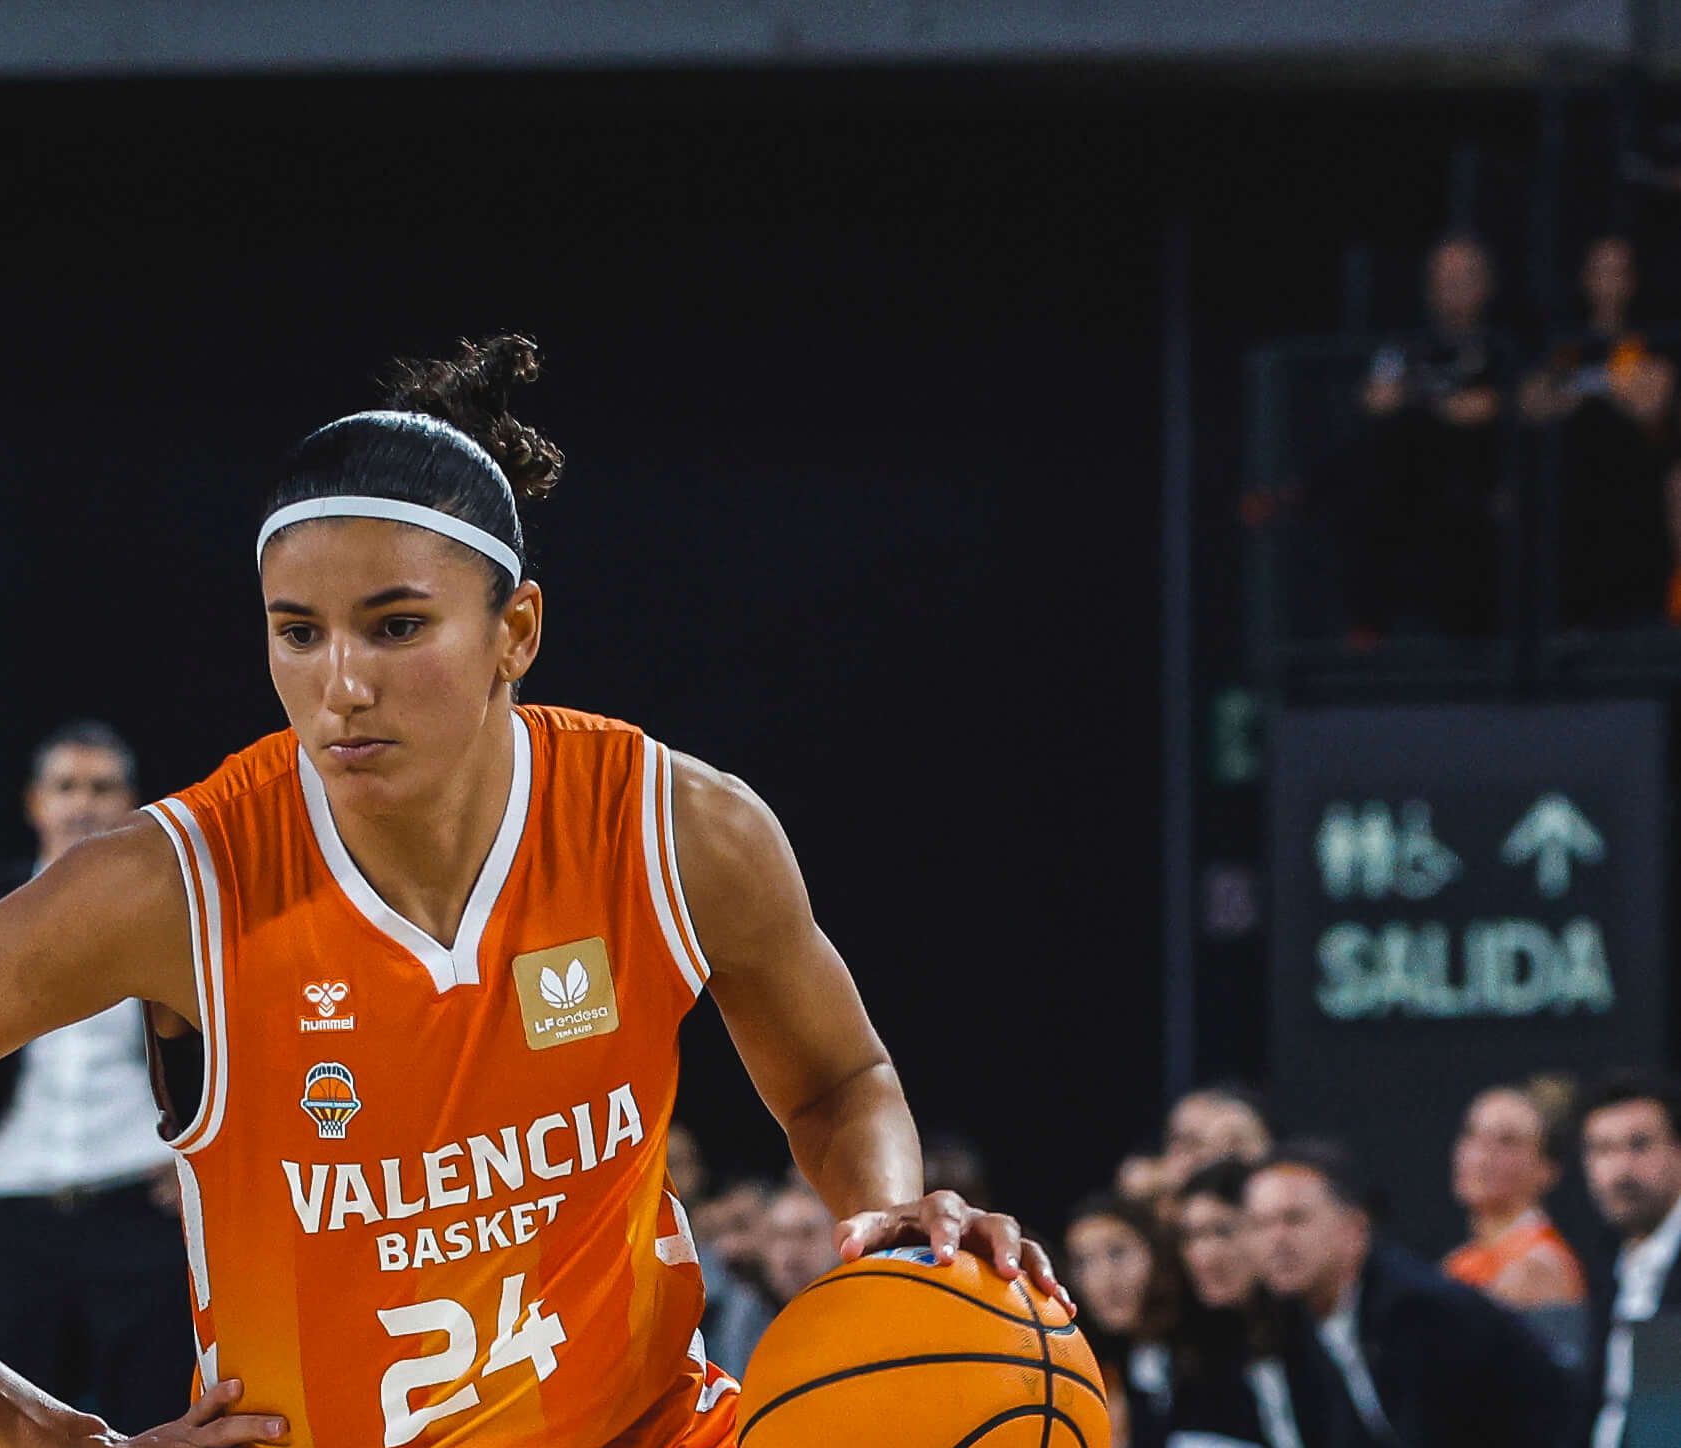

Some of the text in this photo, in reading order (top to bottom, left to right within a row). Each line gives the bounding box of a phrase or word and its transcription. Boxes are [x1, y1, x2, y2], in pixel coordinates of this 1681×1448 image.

[1317, 918, 1613, 1019] SALIDA
[300, 1015, 354, 1031] hummel
[534, 1007, 608, 1034] LF endesa
[281, 1083, 644, 1233] VALENCIA
[375, 1193, 567, 1271] BASKET
[377, 1272, 568, 1448] 24
